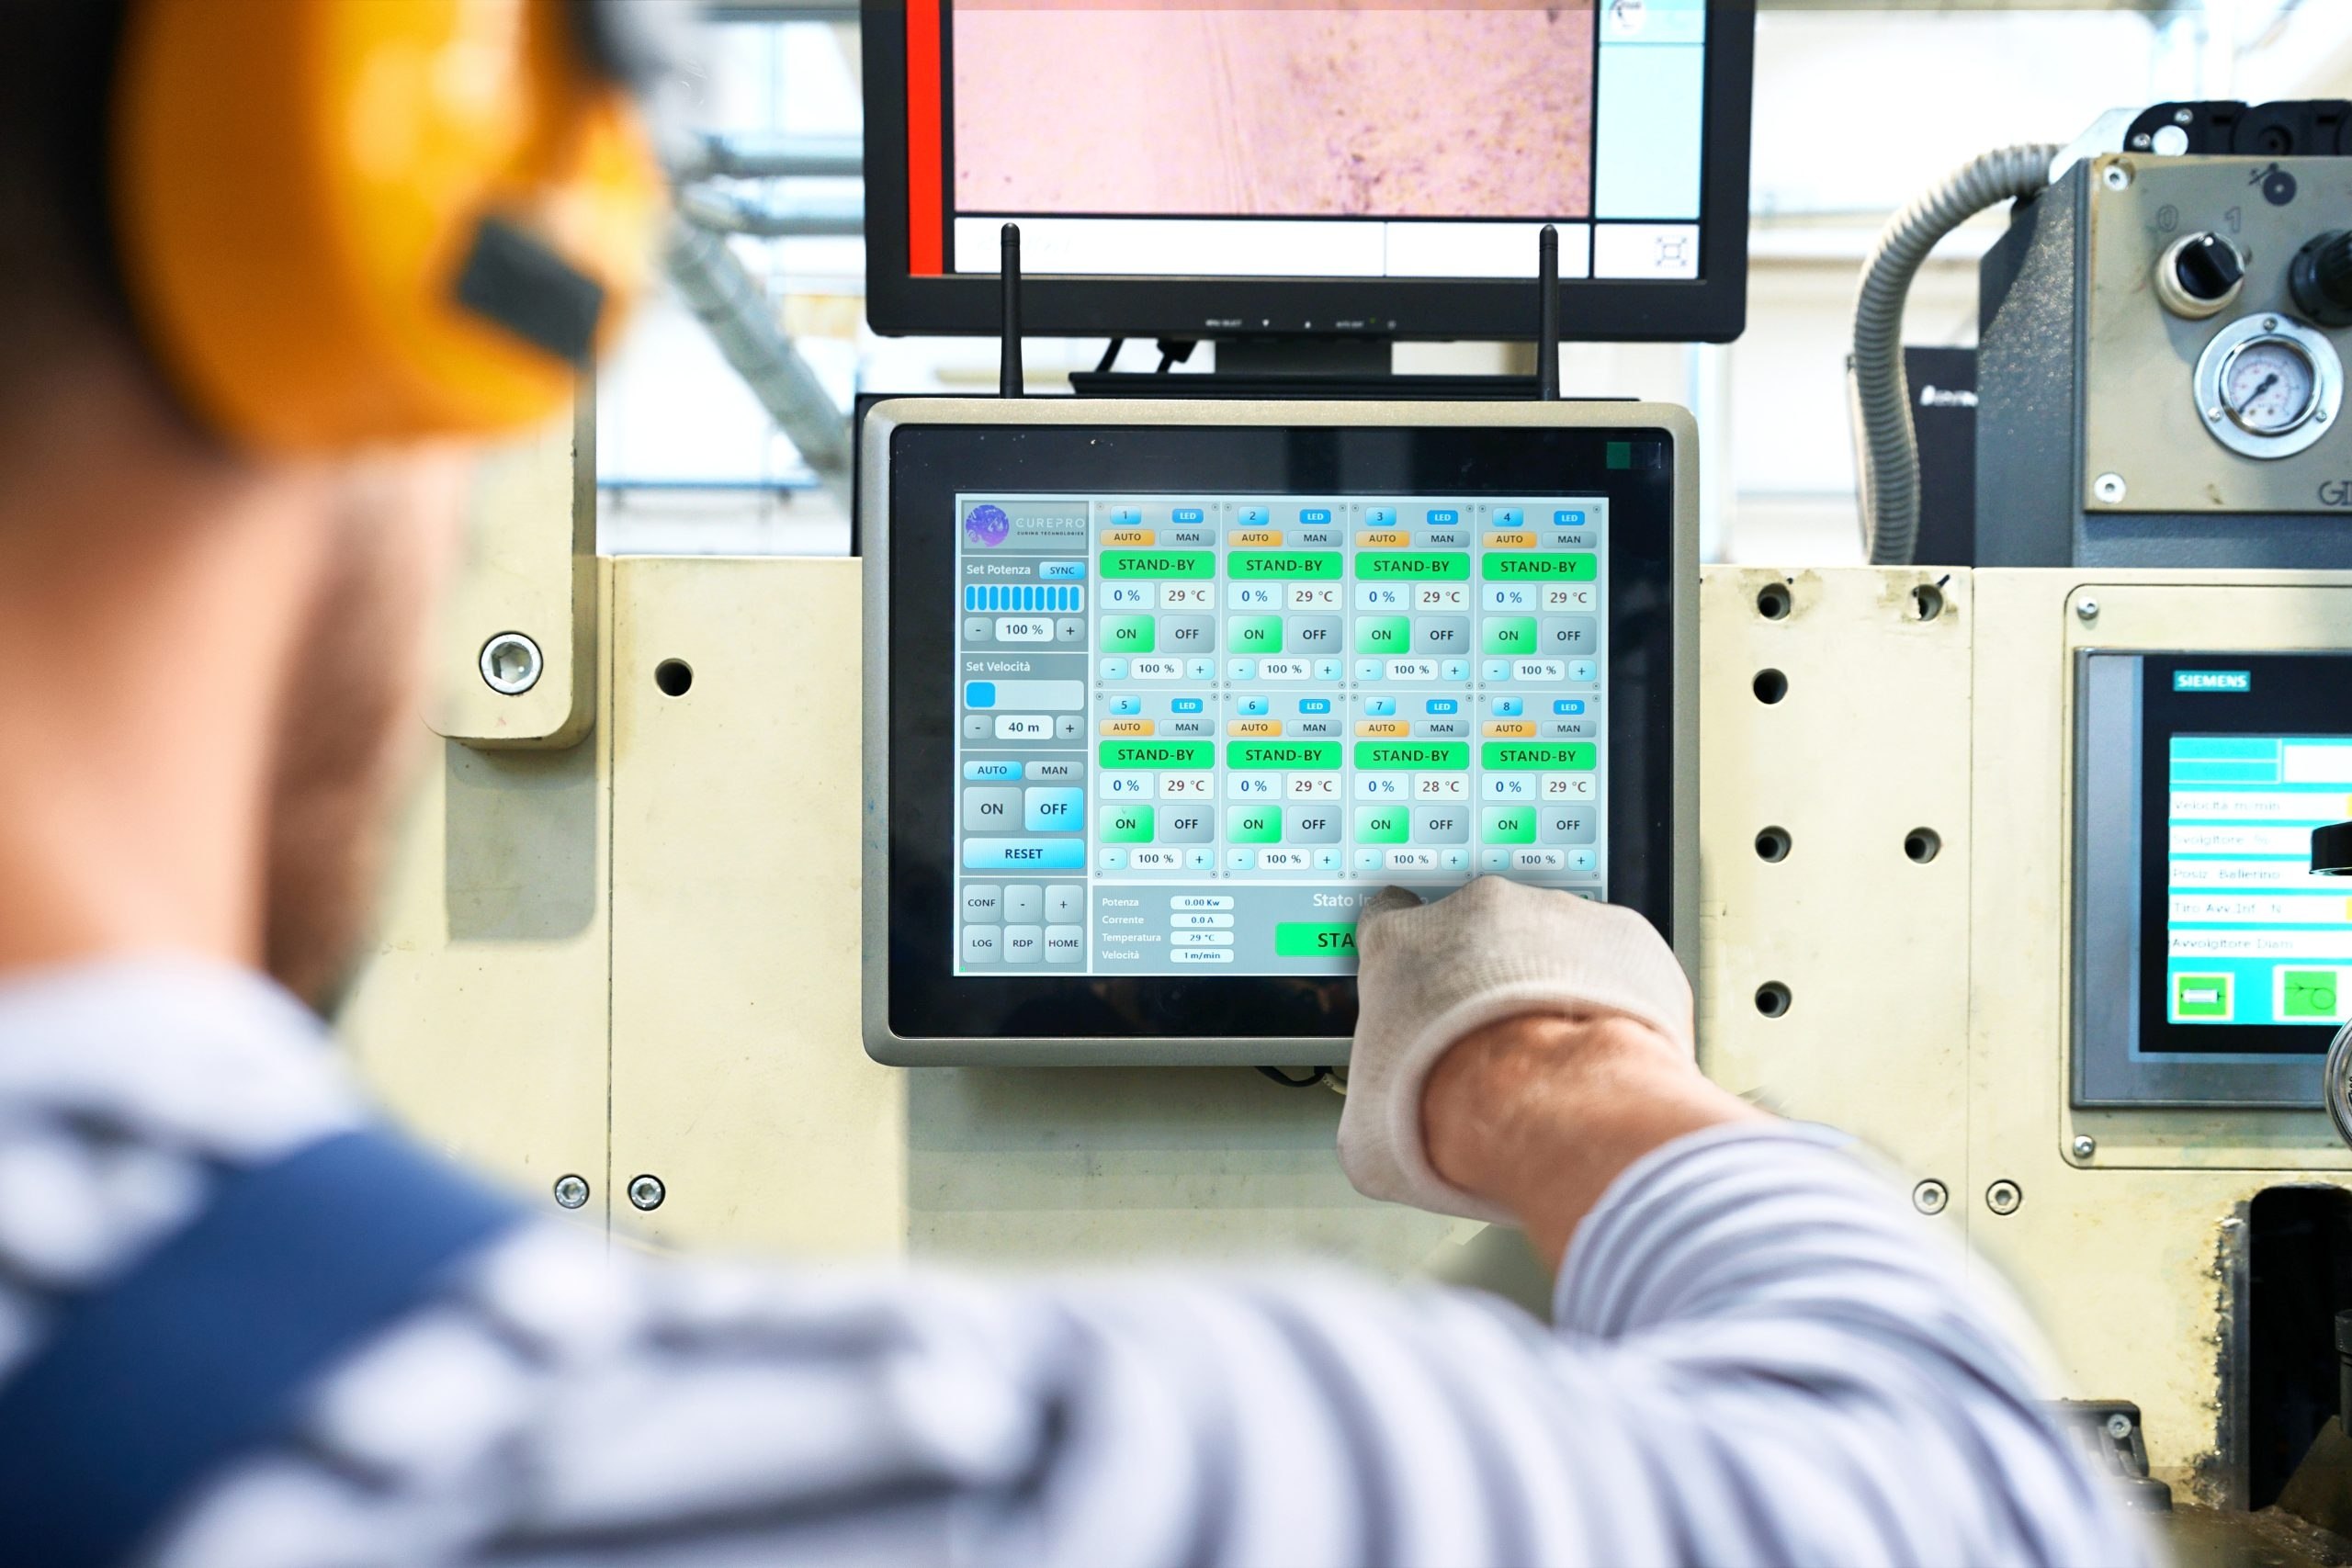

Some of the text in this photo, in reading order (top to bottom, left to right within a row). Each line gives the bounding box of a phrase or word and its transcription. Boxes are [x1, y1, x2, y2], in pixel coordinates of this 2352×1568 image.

[1123, 512, 1128, 520] 1
[1250, 512, 1256, 520] 2
[1377, 513, 1383, 521] 3
[1016, 518, 1085, 528] CUREPRO
[967, 564, 1031, 575] Set Potenza
[1119, 559, 1194, 570] STAND-BY
[1247, 560, 1322, 571] STAND-BY
[1374, 560, 1449, 571] STAND-BY
[1501, 561, 1577, 572] STAND-BY
[1114, 590, 1140, 601] 0 %
[1169, 591, 1205, 601] 29 °C
[1242, 591, 1267, 602] 0 %
[1296, 591, 1332, 602] 29 °C
[1369, 592, 1395, 603] 0 %
[1423, 592, 1460, 603] 29 °C
[1497, 592, 1521, 603] 0 %
[1551, 592, 1587, 603] 29 °C
[1007, 625, 1043, 635] 100 %
[1116, 629, 1136, 638] ON
[1175, 629, 1198, 638] OFF
[1244, 630, 1263, 639] ON
[1303, 630, 1326, 639] OFF
[1372, 630, 1391, 639] ON
[1430, 631, 1453, 640] OFF
[1498, 631, 1518, 640] ON
[1557, 631, 1580, 640] OFF
[966, 660, 1030, 672] Set Velocità
[1140, 664, 1174, 672] 100 %
[1268, 665, 1302, 673] 100 %
[1419, 666, 1429, 674] %
[1522, 666, 1556, 674] 100 %
[2178, 674, 2246, 687] SIEMENS
[1122, 701, 1127, 709] 5
[1250, 701, 1255, 709] 6
[1376, 702, 1383, 710] 7
[1504, 702, 1510, 711] 8
[1009, 723, 1023, 732] 40
[1118, 750, 1194, 761] STAND-BY
[1246, 750, 1321, 761] STAND-BY
[1374, 750, 1449, 761] STAND-BY
[1500, 750, 1576, 761] STAND-BY
[978, 766, 1007, 774] AUTO
[1042, 766, 1067, 774] MAN
[1114, 780, 1139, 791] 0 %
[1168, 780, 1204, 791] 29 °C
[1241, 781, 1267, 791] 0 %
[1295, 781, 1331, 792] 29 °C
[1369, 781, 1394, 792] 0 %
[1423, 781, 1459, 792] 28 °C
[1496, 782, 1521, 792] 0 %
[1550, 782, 1586, 792] 29 °C
[981, 804, 1002, 814] ON
[1040, 804, 1067, 815] OFF
[1116, 819, 1135, 829] ON
[1175, 819, 1198, 829] OFF
[1244, 819, 1262, 829] ON
[1302, 819, 1326, 829] OFF
[1371, 820, 1390, 829] ON
[1430, 820, 1453, 829] OFF
[1498, 820, 1517, 829] ON
[1556, 820, 1579, 829] OFF
[1005, 849, 1043, 859] RESET
[1139, 854, 1173, 863] 100 %
[1267, 855, 1301, 863] 100 %
[1395, 855, 1429, 863] 100 %
[1521, 855, 1555, 863] 100 %
[1314, 894, 1353, 907] Stato
[1102, 933, 1161, 943] Temperatura
[1102, 951, 1139, 959] Velocità
